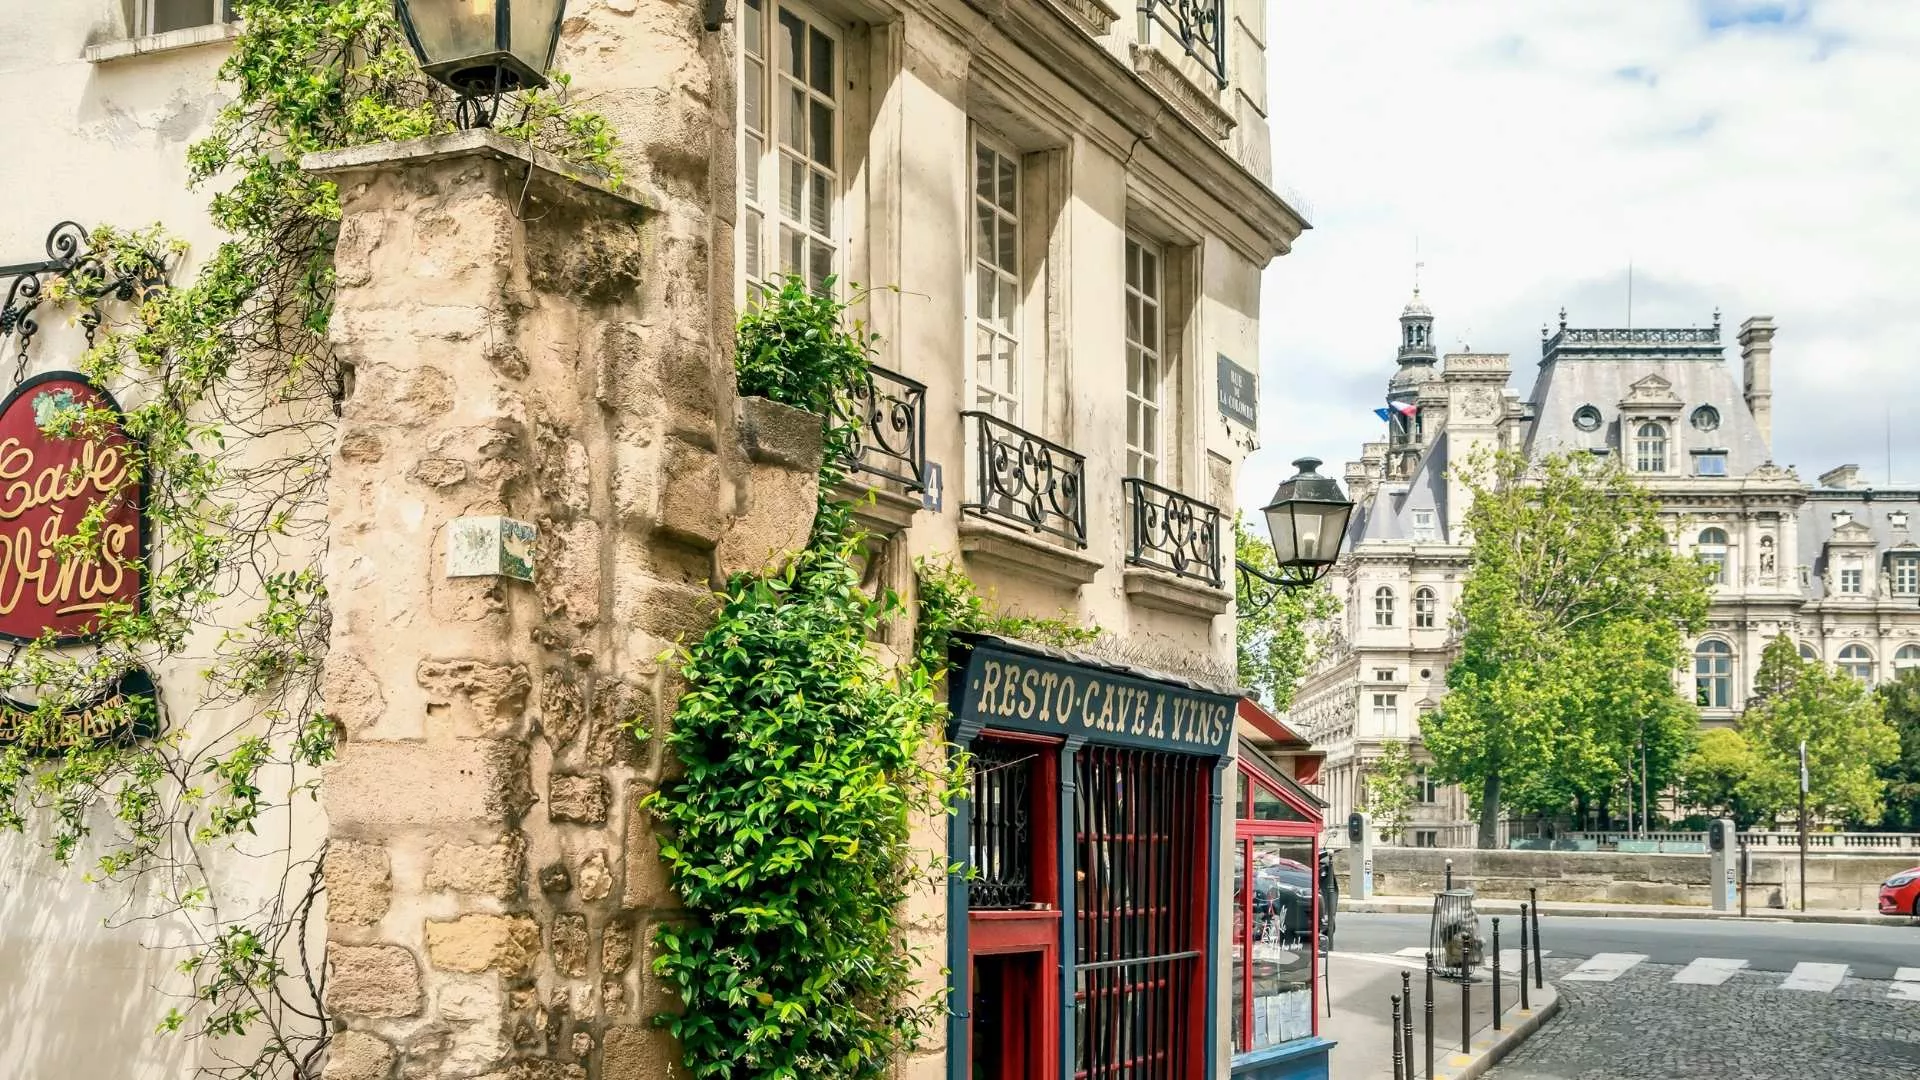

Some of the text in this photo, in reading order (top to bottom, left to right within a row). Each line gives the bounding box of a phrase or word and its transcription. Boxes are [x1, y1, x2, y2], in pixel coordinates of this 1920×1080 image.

[1219, 389, 1227, 405] LA
[1230, 369, 1242, 388] RUE
[0, 437, 127, 519] Cave
[928, 468, 939, 505] 4
[40, 504, 65, 547] à
[0, 522, 134, 615] Vins
[978, 660, 1075, 724] RESTO
[1082, 680, 1149, 736] CAVE
[1171, 698, 1227, 746] VINS
